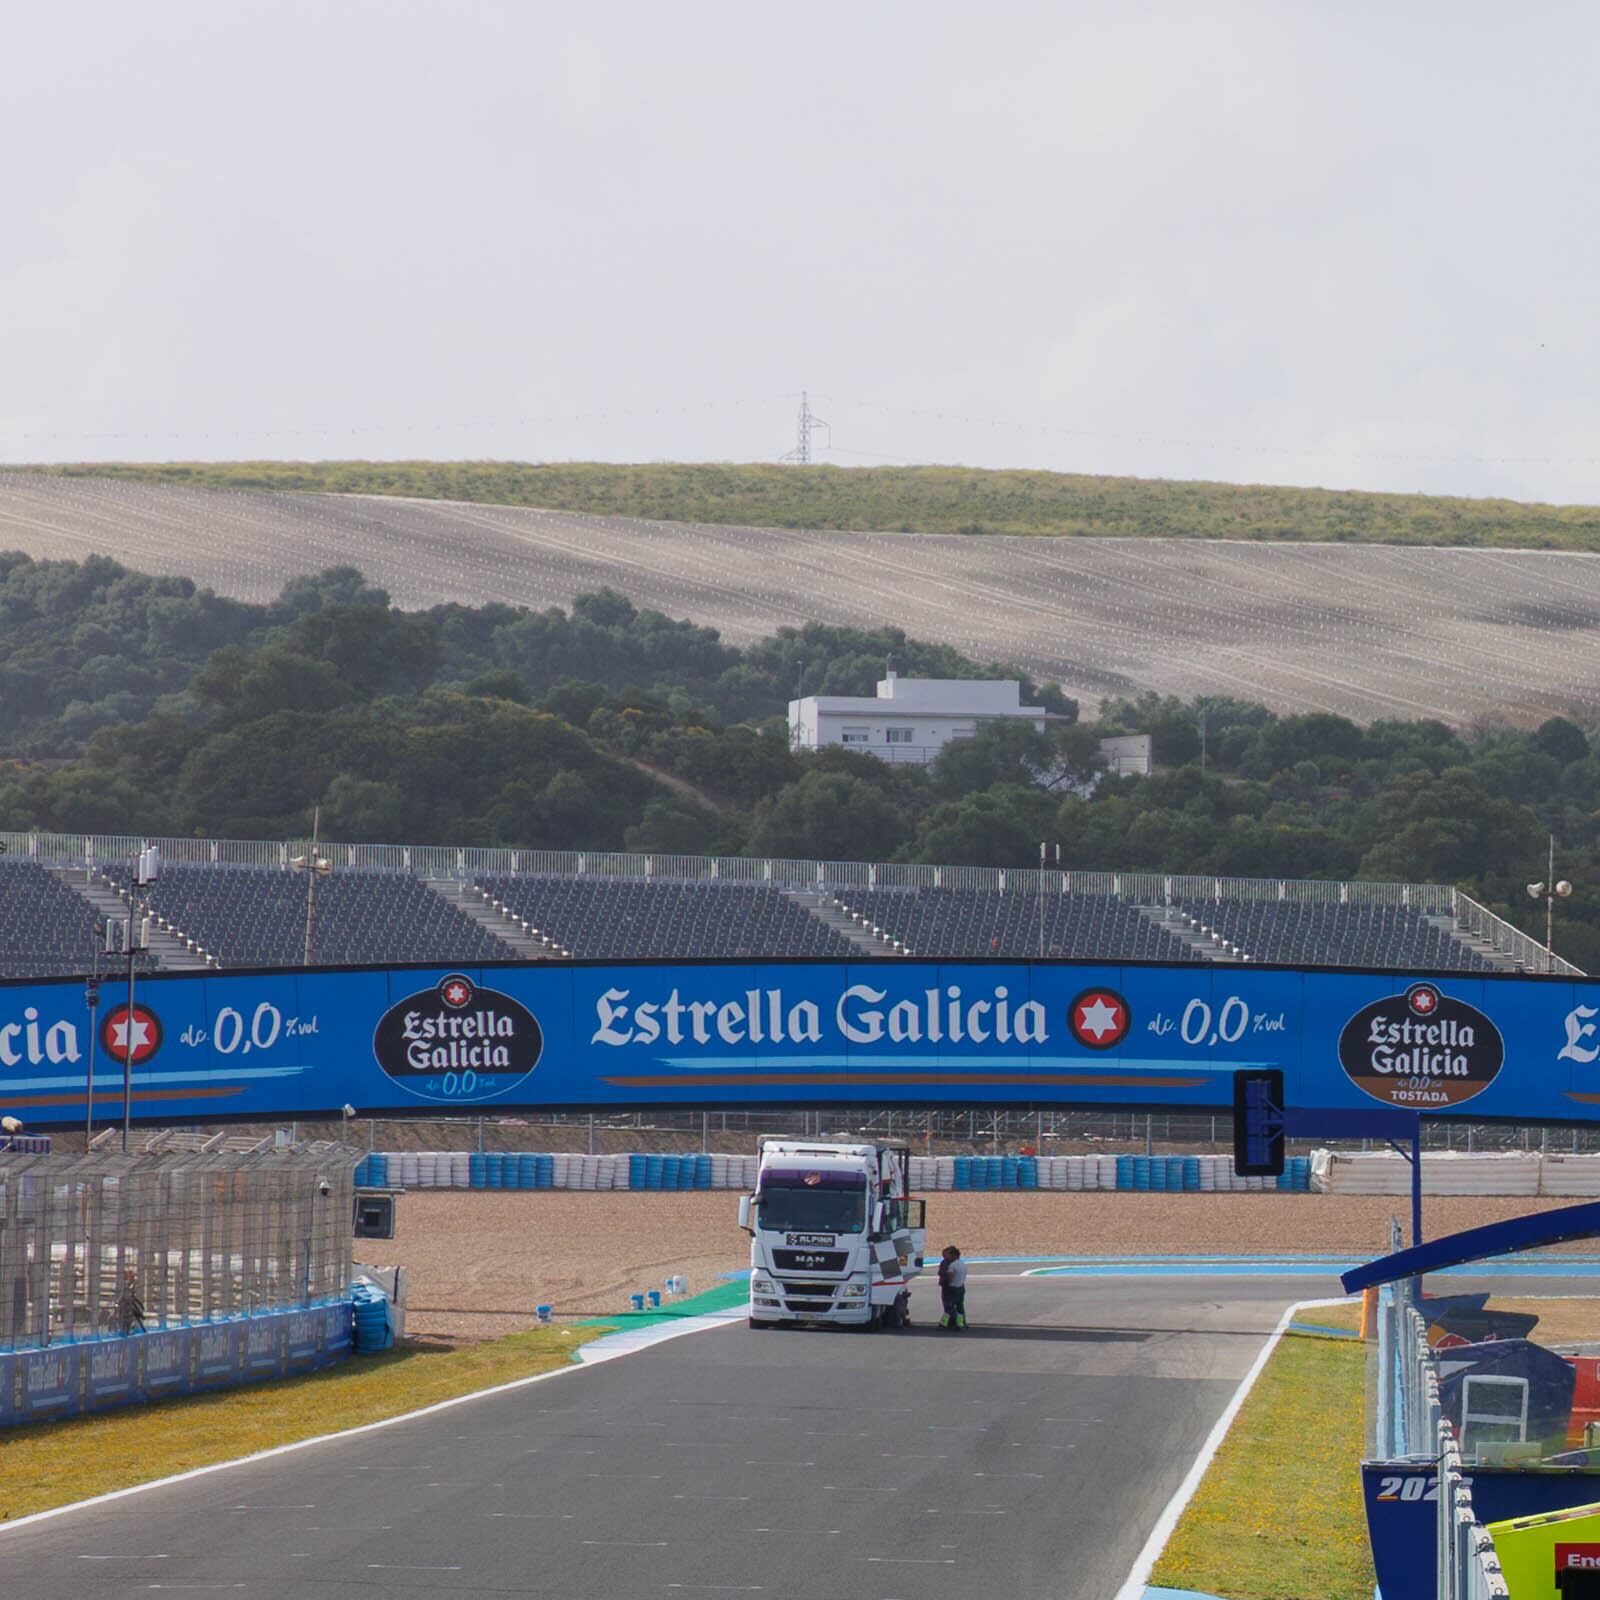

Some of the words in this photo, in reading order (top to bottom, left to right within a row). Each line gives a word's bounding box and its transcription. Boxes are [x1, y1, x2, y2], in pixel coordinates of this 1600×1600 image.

[214, 1002, 281, 1054] 0,0
[402, 1010, 515, 1040] Estrella
[591, 987, 823, 1045] Estrella
[836, 984, 1049, 1045] Galicia
[1181, 996, 1249, 1046] 0,0
[1367, 1016, 1475, 1047] Estrella
[407, 1040, 511, 1069] Galicia
[1371, 1044, 1470, 1076] Galicia
[442, 1069, 477, 1096] 0,0
[1389, 1090, 1449, 1102] TOSTADA
[795, 1255, 825, 1263] MAN
[1377, 1477, 1473, 1501] 202
